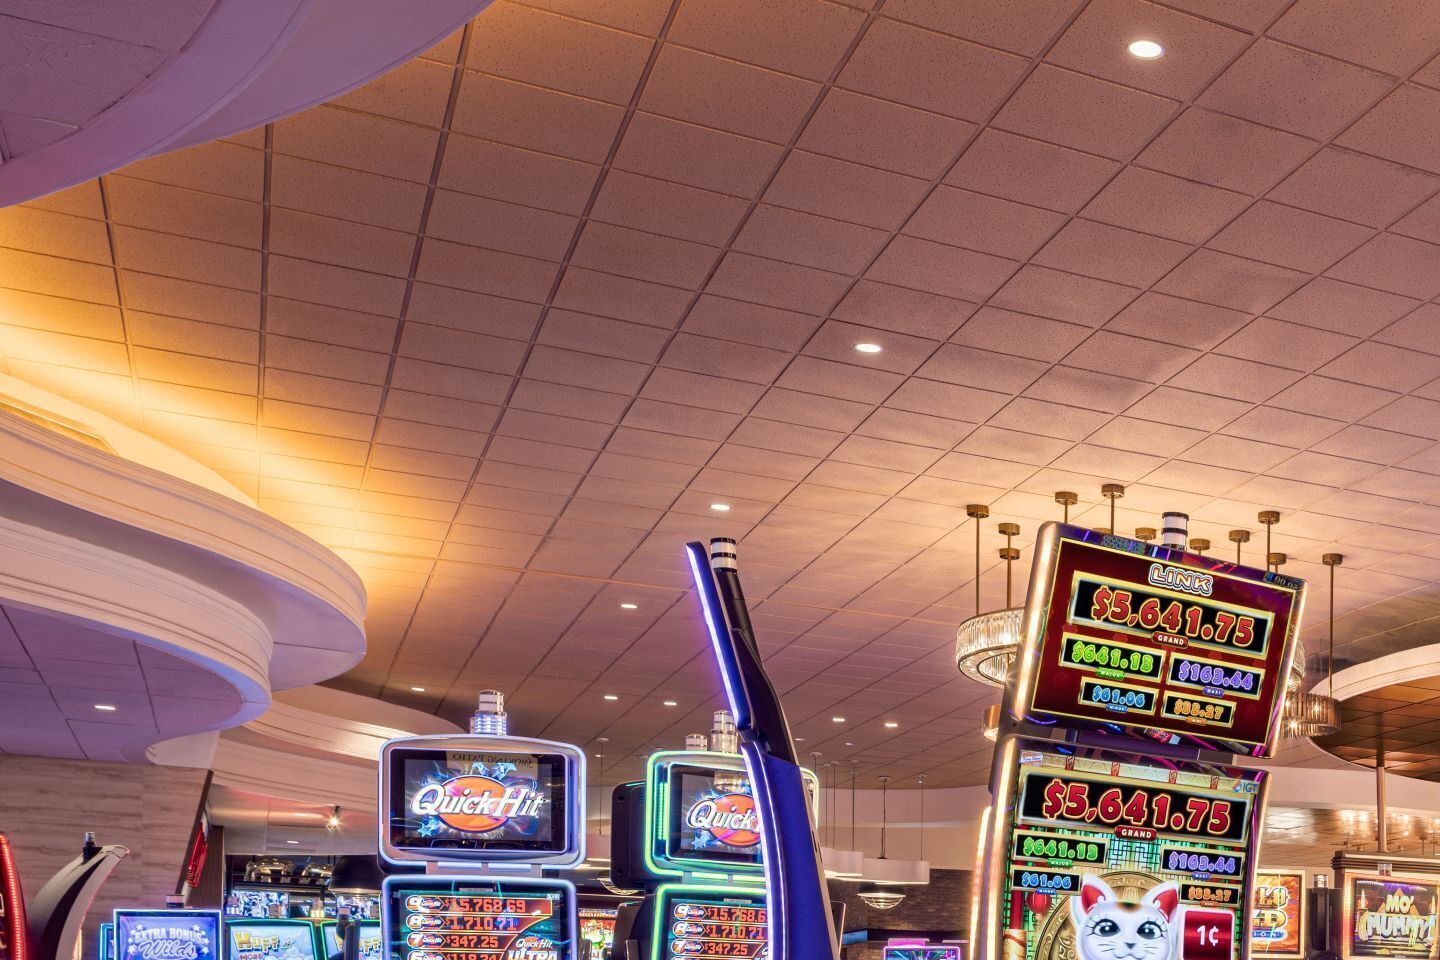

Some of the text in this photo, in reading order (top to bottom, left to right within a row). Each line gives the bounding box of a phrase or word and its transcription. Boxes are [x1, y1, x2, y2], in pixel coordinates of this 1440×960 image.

[1149, 564, 1213, 595] LINK
[1091, 586, 1255, 646] $5,641.75
[1157, 634, 1184, 646] GRAND
[1072, 641, 1154, 673] $641.13
[1178, 660, 1254, 691] $163.44
[1092, 685, 1145, 707] $61.06
[1242, 782, 1258, 793] IGT
[411, 784, 545, 818] Quick Hit
[1043, 778, 1231, 835] $5,641.75
[686, 799, 754, 831] Quick
[1121, 828, 1152, 839] GRAND
[1023, 836, 1098, 861] $641.13
[1168, 852, 1235, 873] $163.44
[1021, 872, 1072, 889] $61.06
[1385, 894, 1414, 914] MO'
[707, 907, 767, 922] $15.768.6
[134, 928, 205, 944] EXTRA BONUS
[446, 935, 499, 948] $347.25
[516, 938, 538, 948] Quick
[1196, 925, 1220, 947] 1¢
[138, 940, 198, 960] Wilds
[704, 942, 748, 956] $347.25
